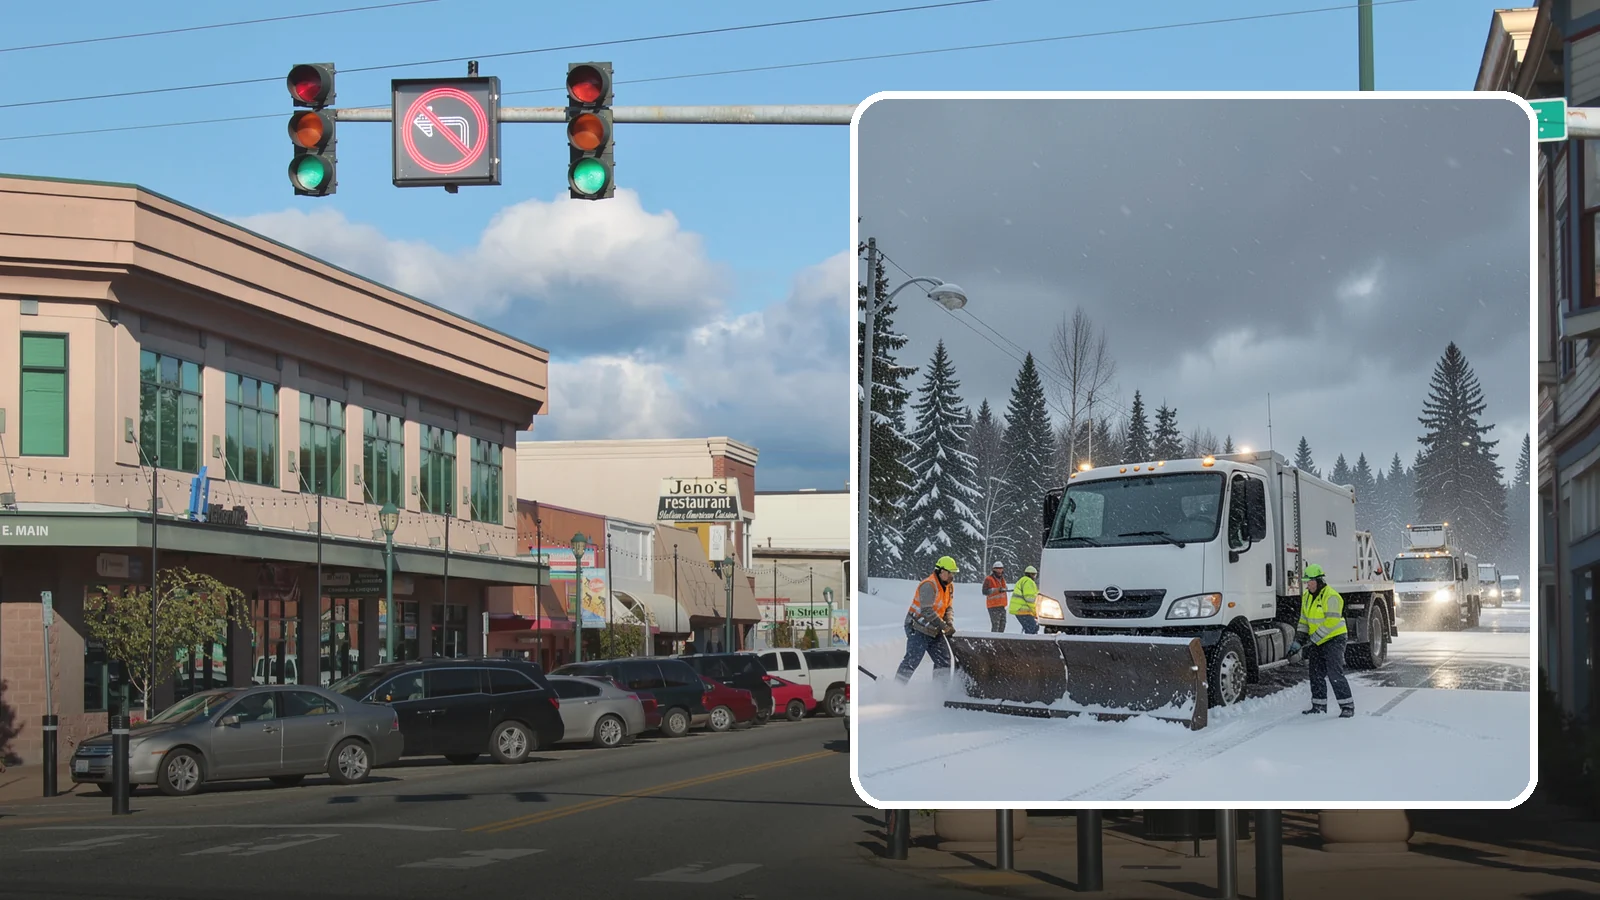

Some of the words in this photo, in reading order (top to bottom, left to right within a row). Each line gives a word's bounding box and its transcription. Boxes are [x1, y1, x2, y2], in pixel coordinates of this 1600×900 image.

[669, 480, 728, 494] Jeno's
[665, 496, 731, 509] restaurant
[659, 510, 682, 519] Italian
[686, 510, 714, 519] American
[715, 510, 737, 519] Cuisine
[2, 525, 13, 536] E.
[15, 525, 49, 536] MAIN
[797, 608, 829, 617] Street
